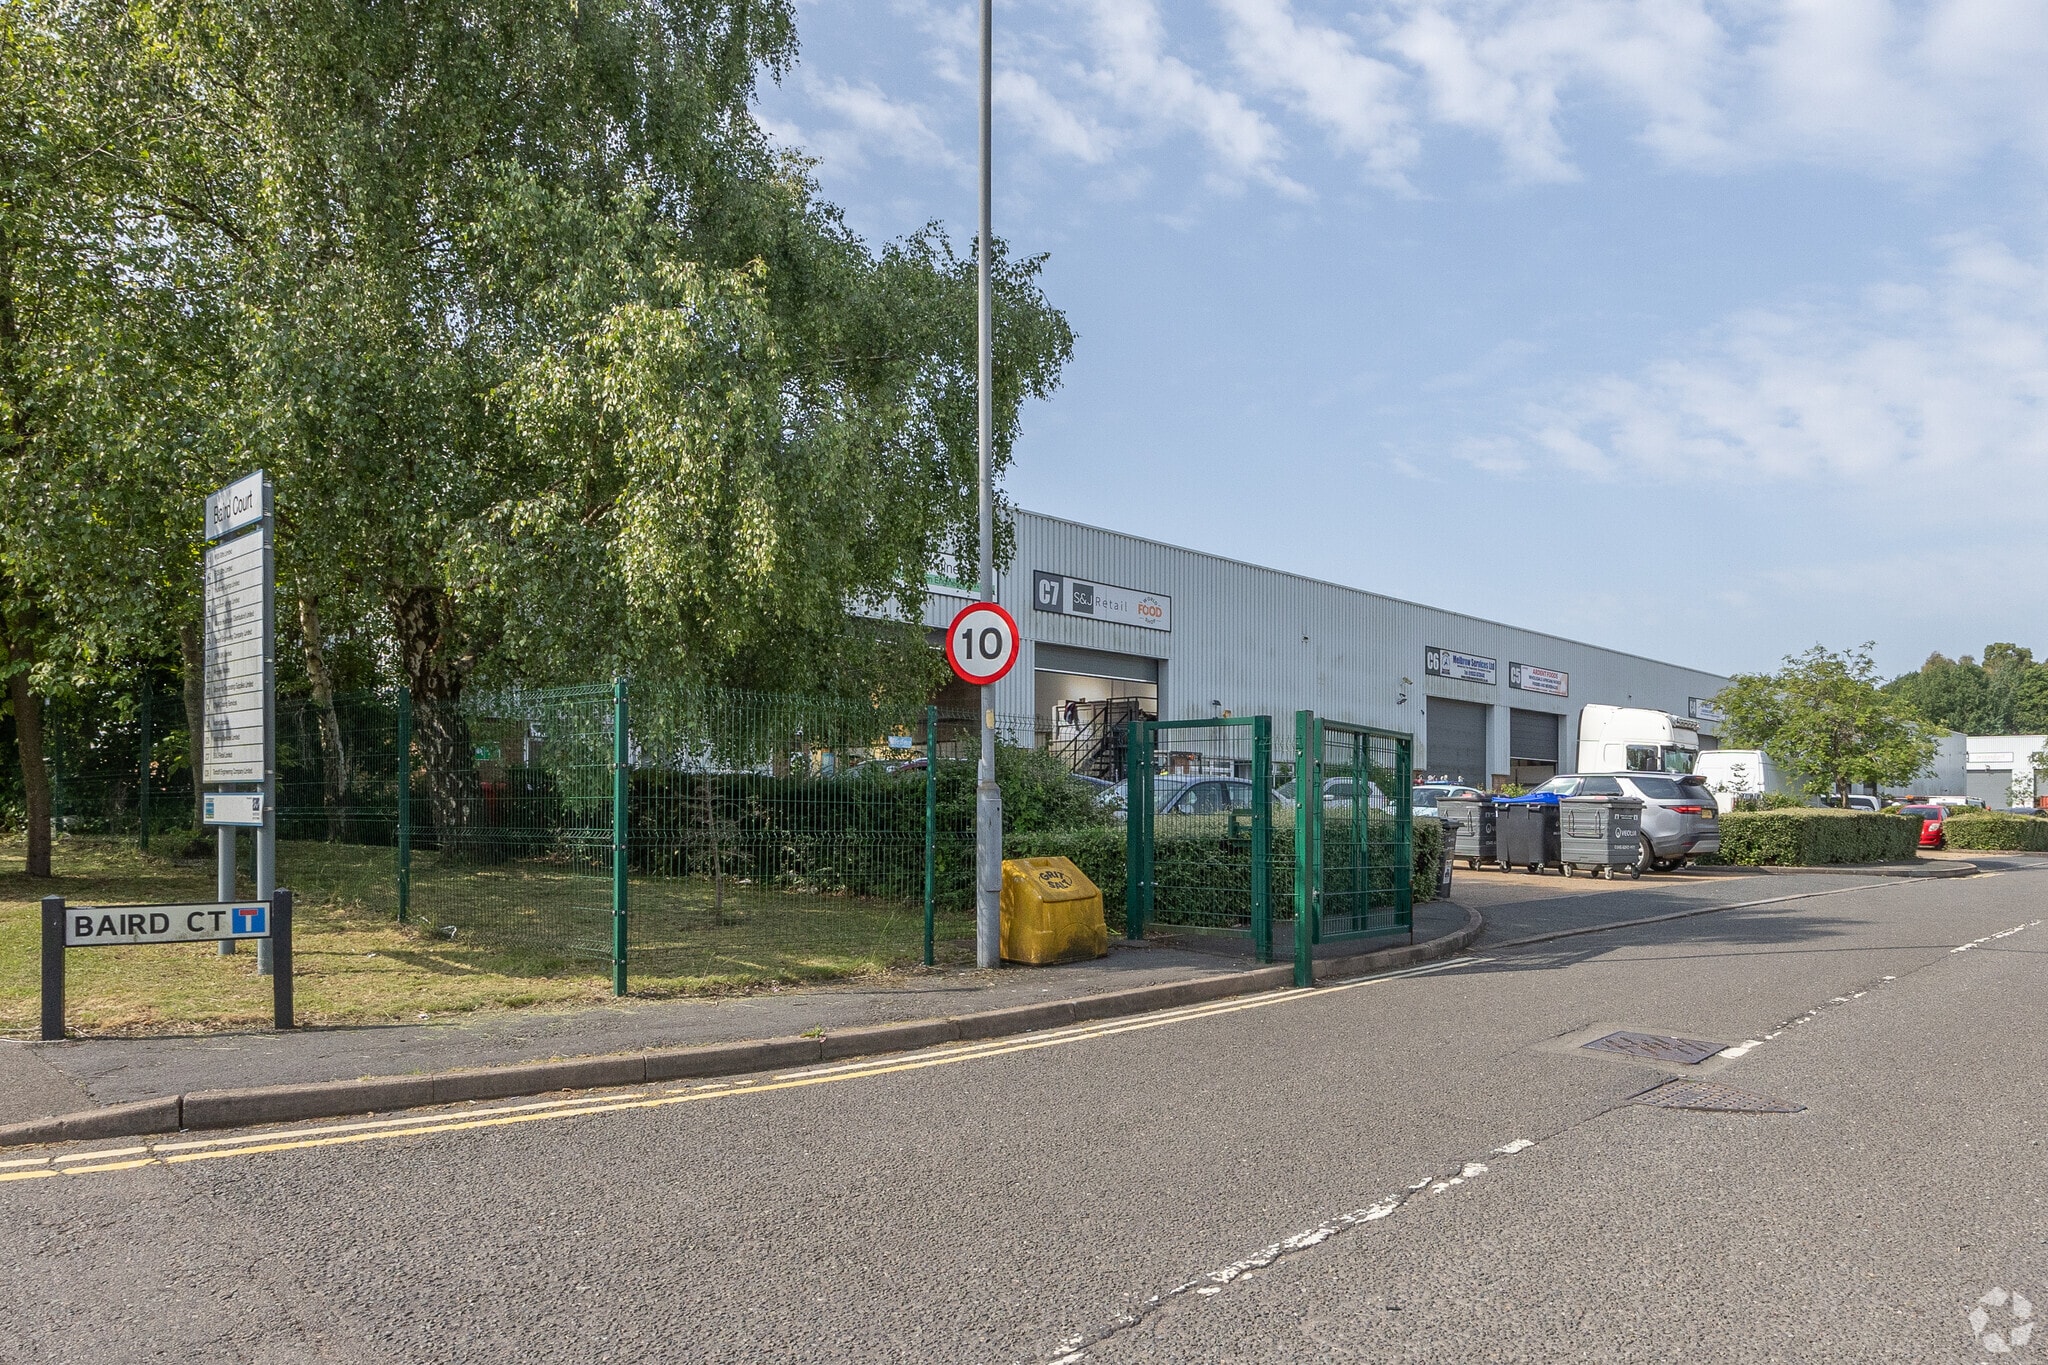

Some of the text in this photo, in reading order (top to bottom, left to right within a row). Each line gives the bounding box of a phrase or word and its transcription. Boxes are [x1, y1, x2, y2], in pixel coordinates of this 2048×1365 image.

[233, 490, 253, 516] Court
[1038, 579, 1060, 606] C7
[1073, 591, 1128, 612] S&J Retail
[1138, 604, 1162, 618] FOOD
[962, 627, 1003, 660] 10
[1427, 651, 1439, 670] C6
[1510, 667, 1521, 684] C5
[1039, 871, 1064, 881] GRIT
[75, 911, 227, 938] BAIRD CT
